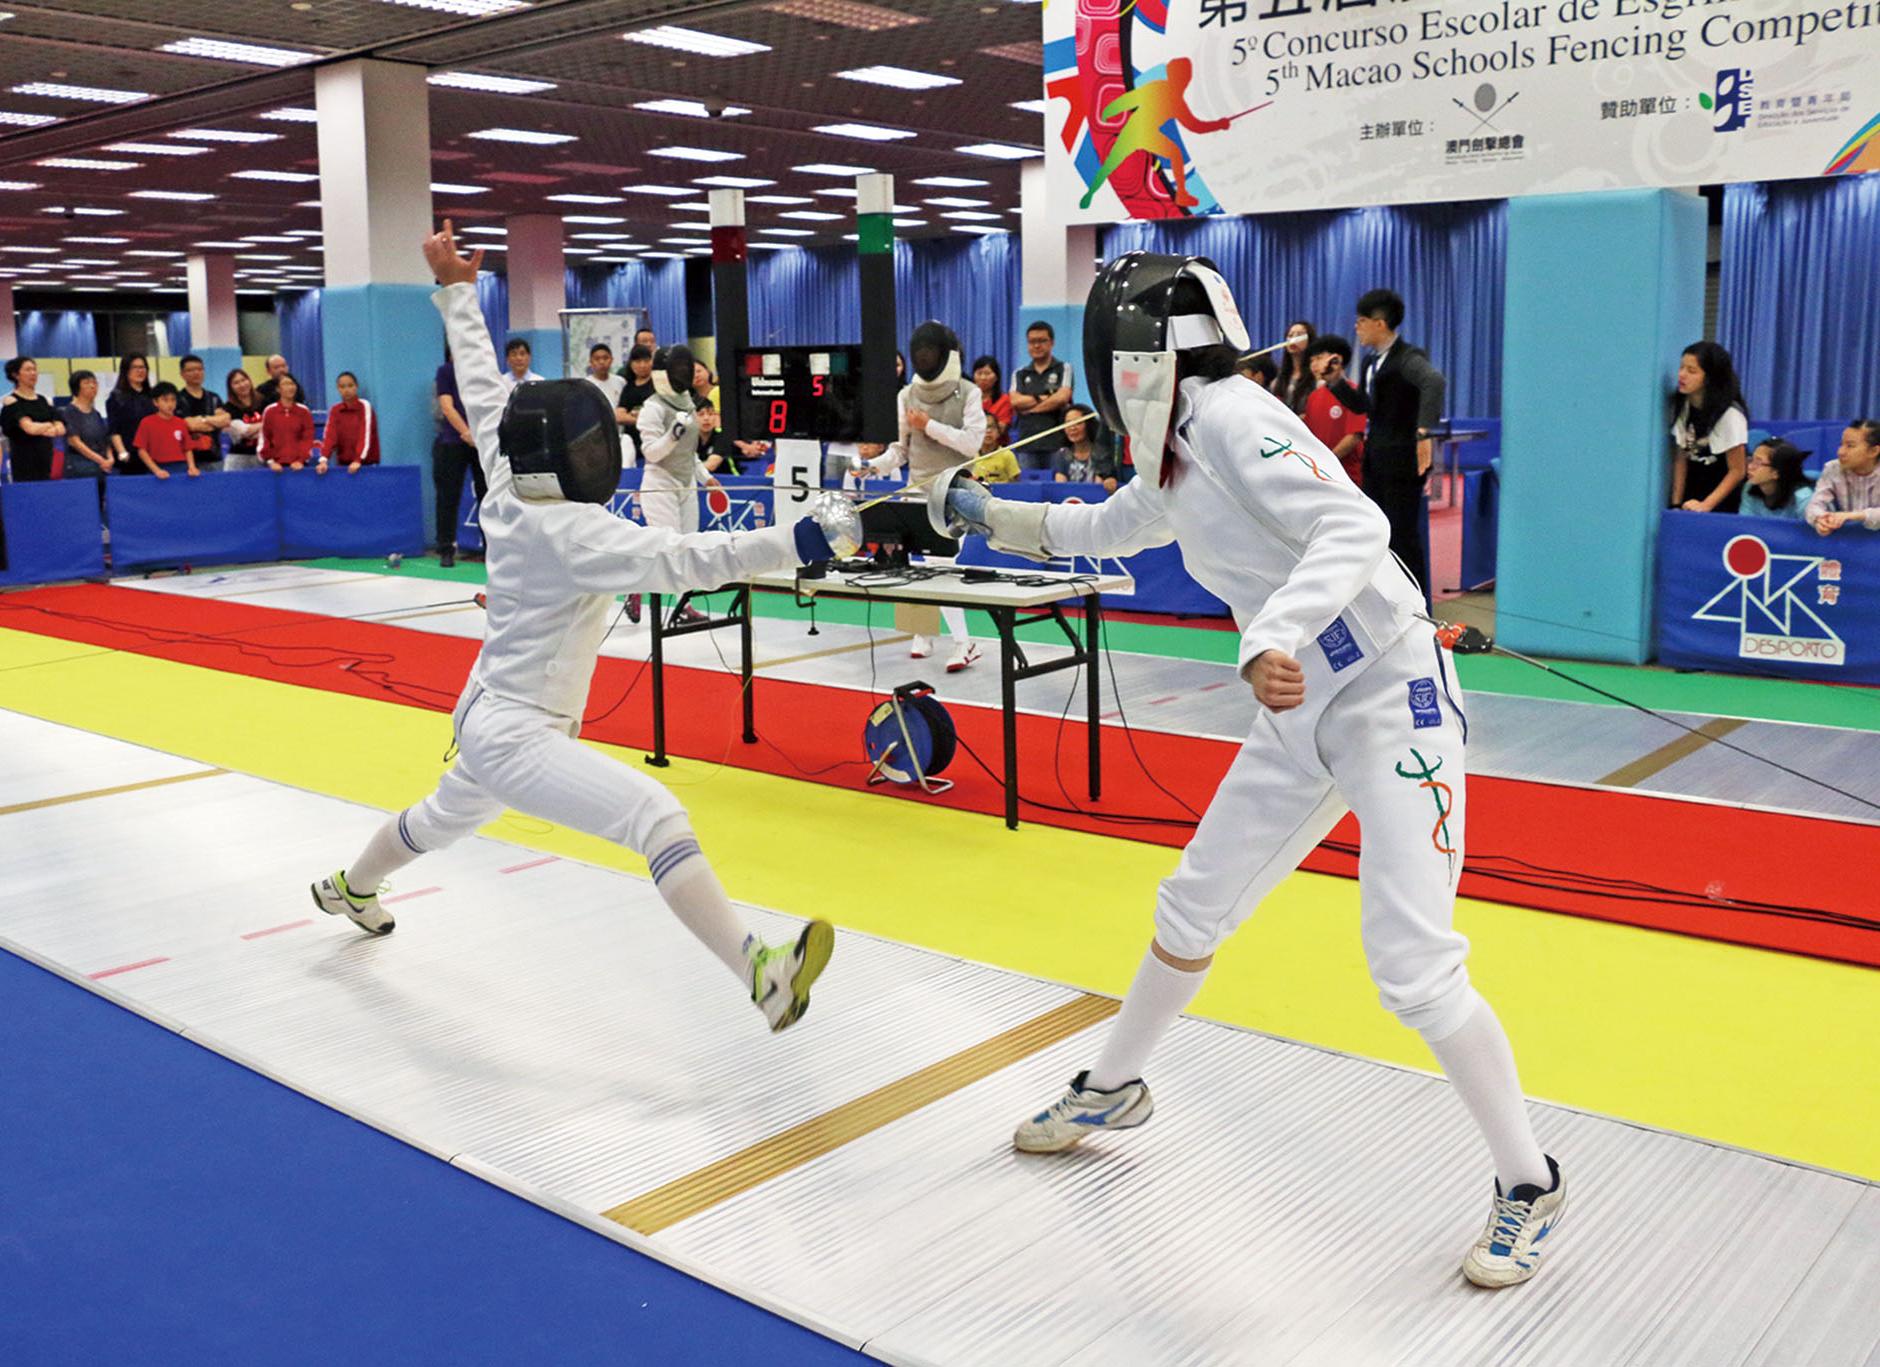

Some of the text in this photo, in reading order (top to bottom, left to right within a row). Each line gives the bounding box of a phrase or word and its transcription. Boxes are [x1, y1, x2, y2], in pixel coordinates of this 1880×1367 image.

[1263, 22, 1408, 60] Concurso
[1420, 1, 1547, 41] Escolar
[1558, 0, 1600, 24] de
[1265, 60, 1299, 96] 5th
[1305, 62, 1402, 92] Macao
[1412, 39, 1535, 81] Schools
[1546, 25, 1688, 66] Fencing
[812, 375, 825, 397] 5
[769, 400, 788, 433] 8
[791, 466, 810, 502] 5
[1745, 637, 1838, 659] DESPORTO
